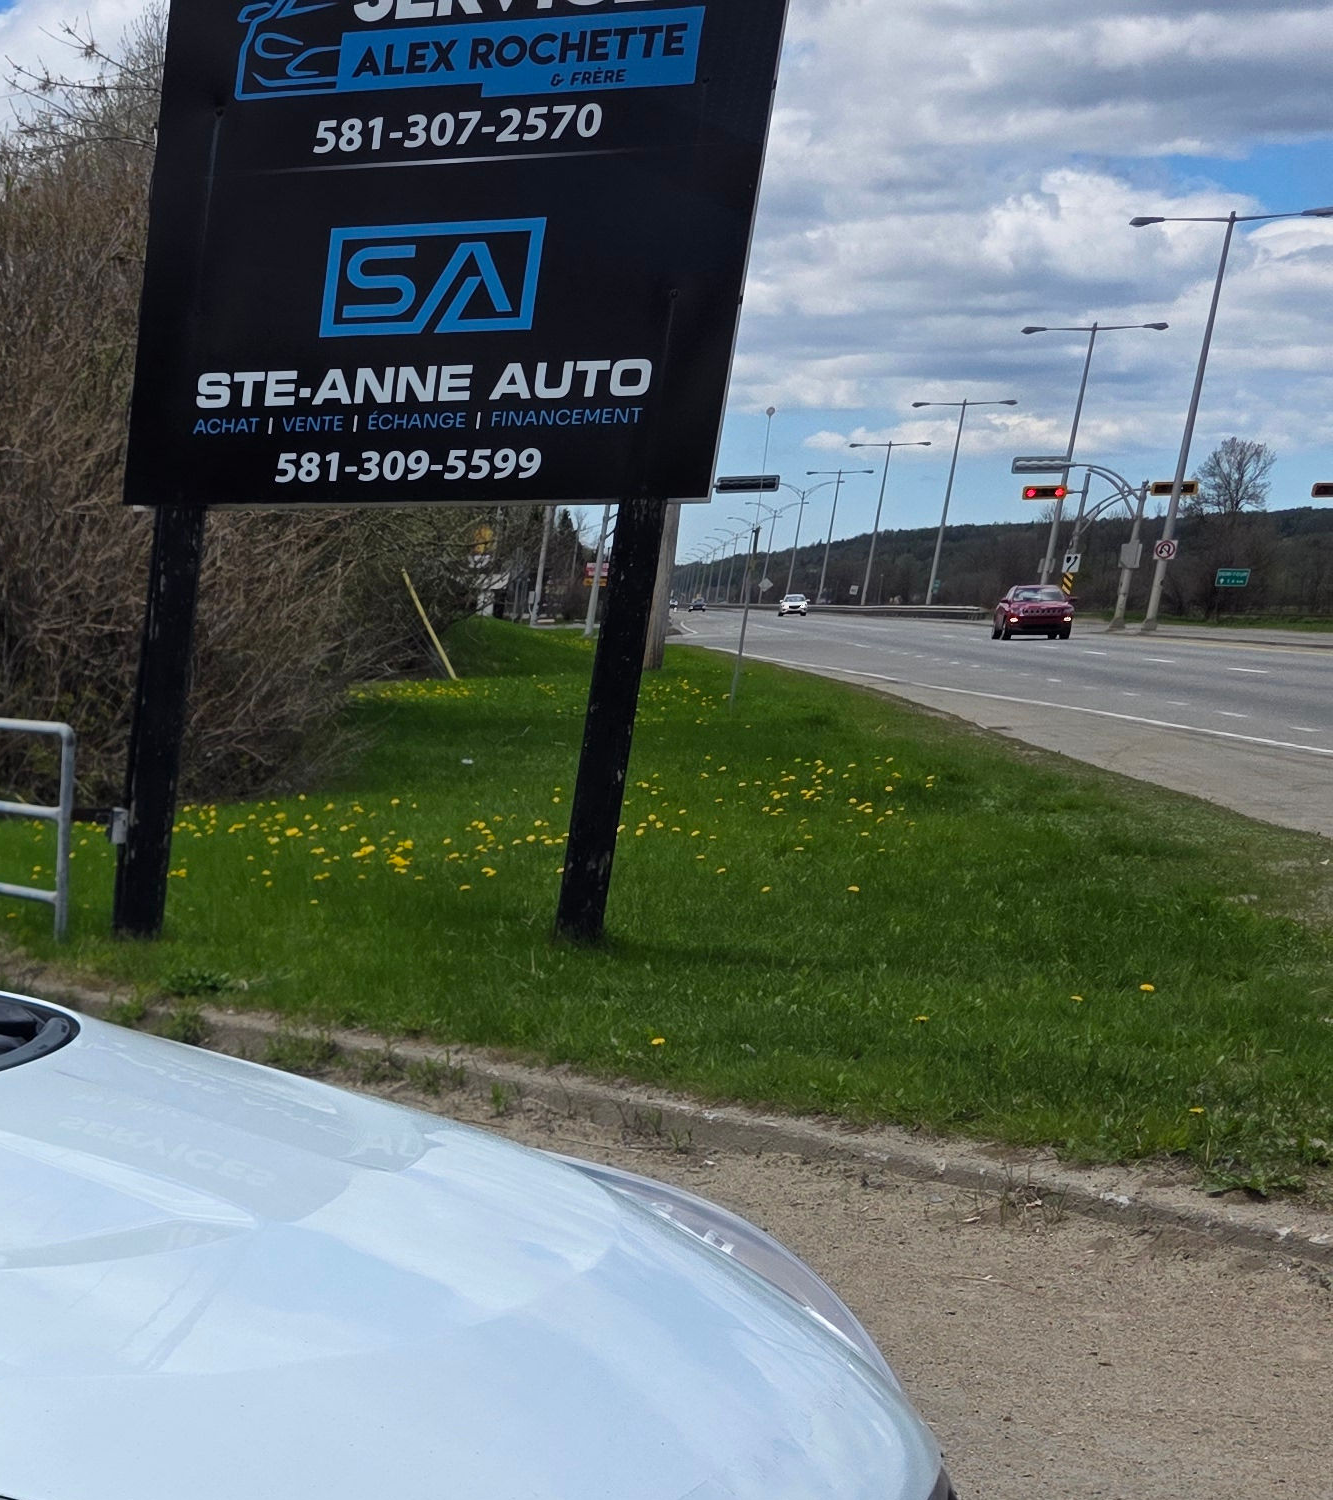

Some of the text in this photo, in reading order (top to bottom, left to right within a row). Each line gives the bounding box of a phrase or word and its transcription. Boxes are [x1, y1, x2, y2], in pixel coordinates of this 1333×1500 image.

[351, 23, 688, 78] ALEX ROCHETTE
[550, 68, 627, 87] & FRÈRE
[312, 102, 603, 154] 581-307-2570
[195, 358, 653, 409] STE-ANNE AUTO
[192, 407, 643, 435] ACHAT VENTE ÉCHANGE FINANCEMENT
[274, 447, 542, 483] 581-309-5599
